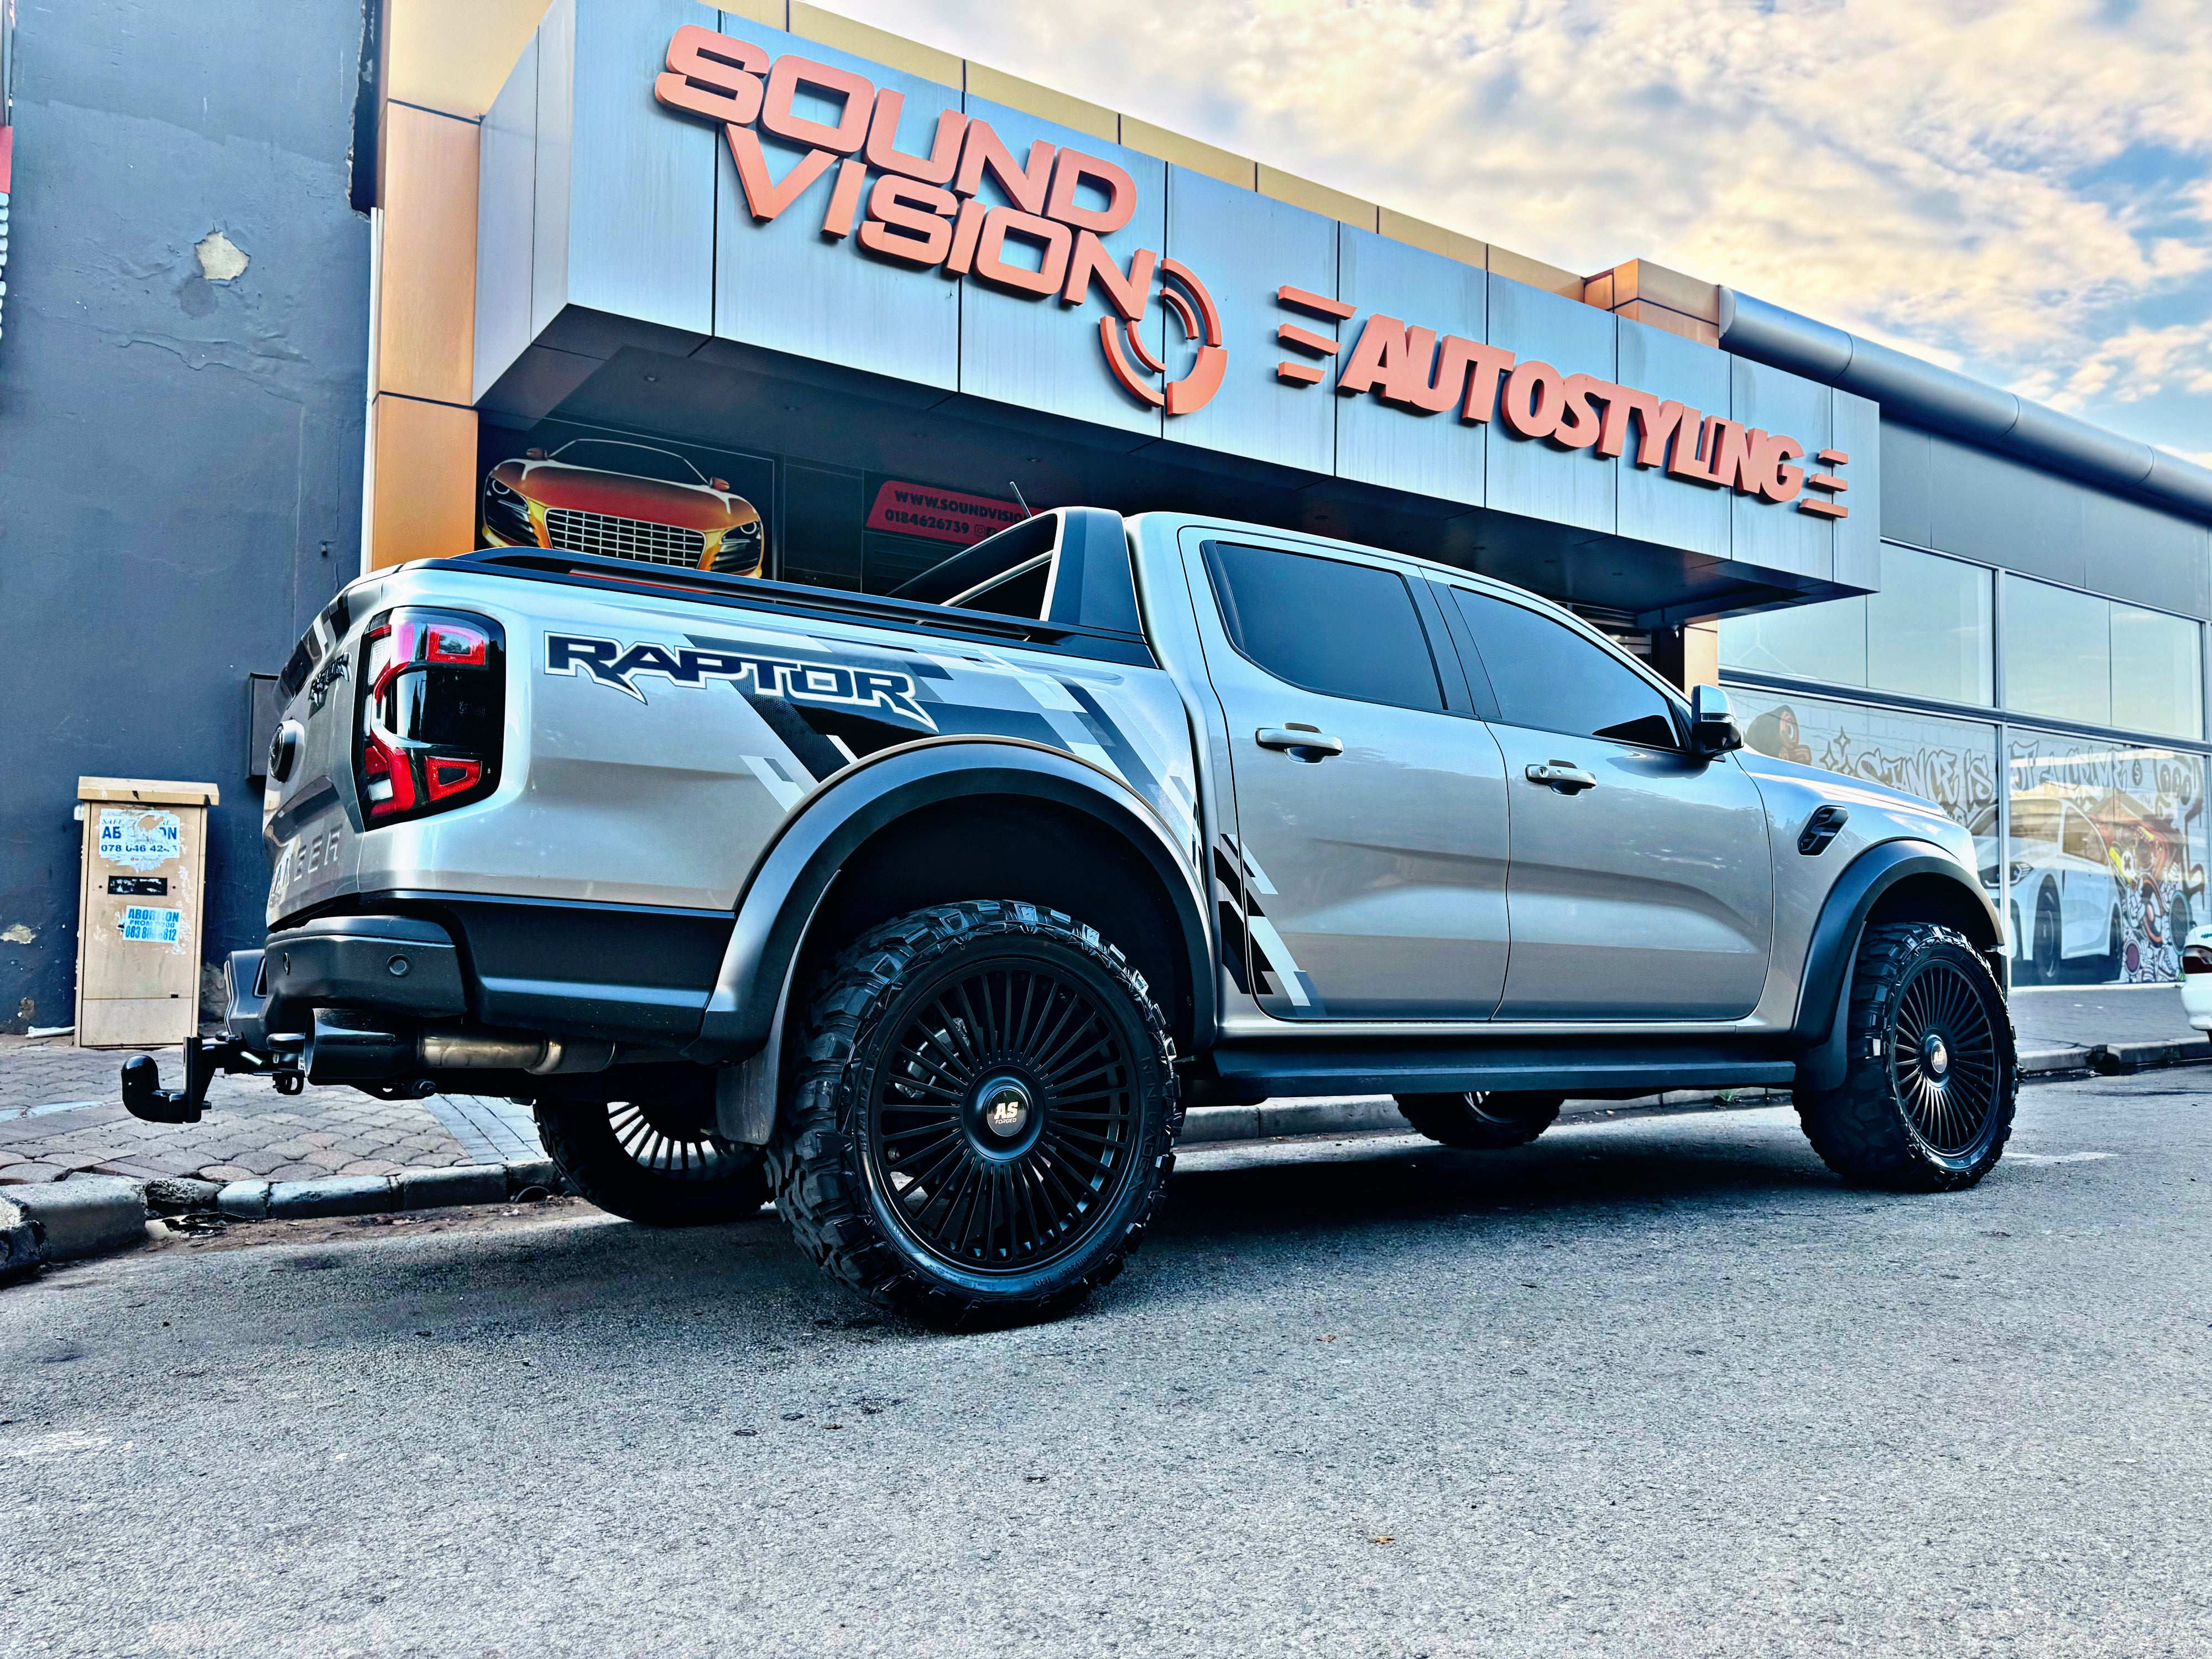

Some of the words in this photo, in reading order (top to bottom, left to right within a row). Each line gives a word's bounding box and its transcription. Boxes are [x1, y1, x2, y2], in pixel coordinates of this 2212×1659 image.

[655, 24, 1137, 233] SOUND
[724, 123, 1157, 321] VISION
[1337, 314, 1804, 502] AUTOSTYLING
[885, 509, 969, 533] 0184626739
[544, 631, 940, 733] RAPTOR
[101, 844, 122, 852] 078
[125, 925, 141, 938] 083
[994, 1102, 1019, 1120] AS
